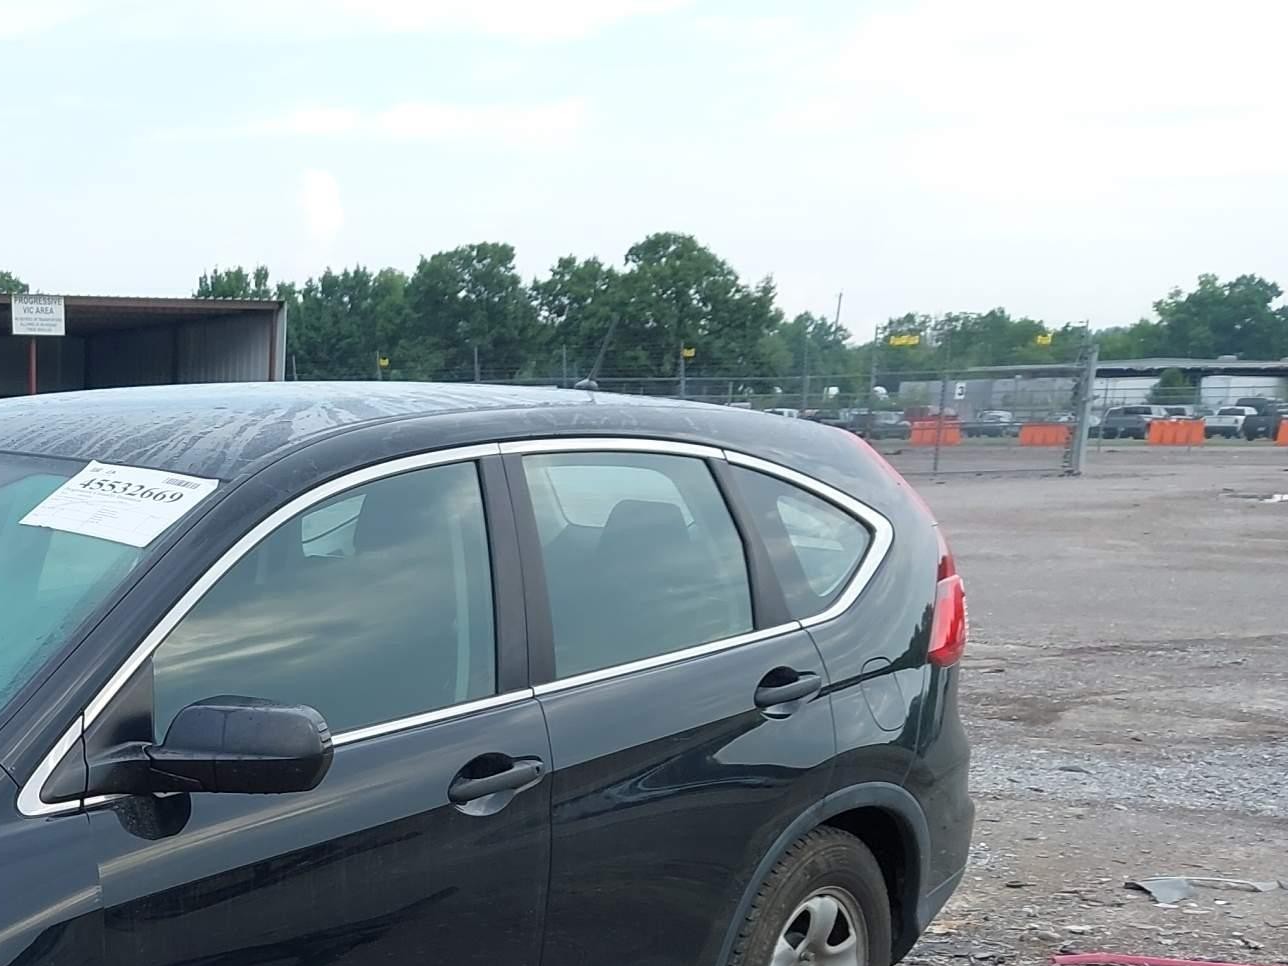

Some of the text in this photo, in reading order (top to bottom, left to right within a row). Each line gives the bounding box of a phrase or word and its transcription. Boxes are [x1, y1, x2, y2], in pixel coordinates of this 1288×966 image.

[14, 296, 62, 306] PROGRESSIVE
[23, 306, 54, 315] VIC AREA
[79, 477, 184, 504] 45532669
